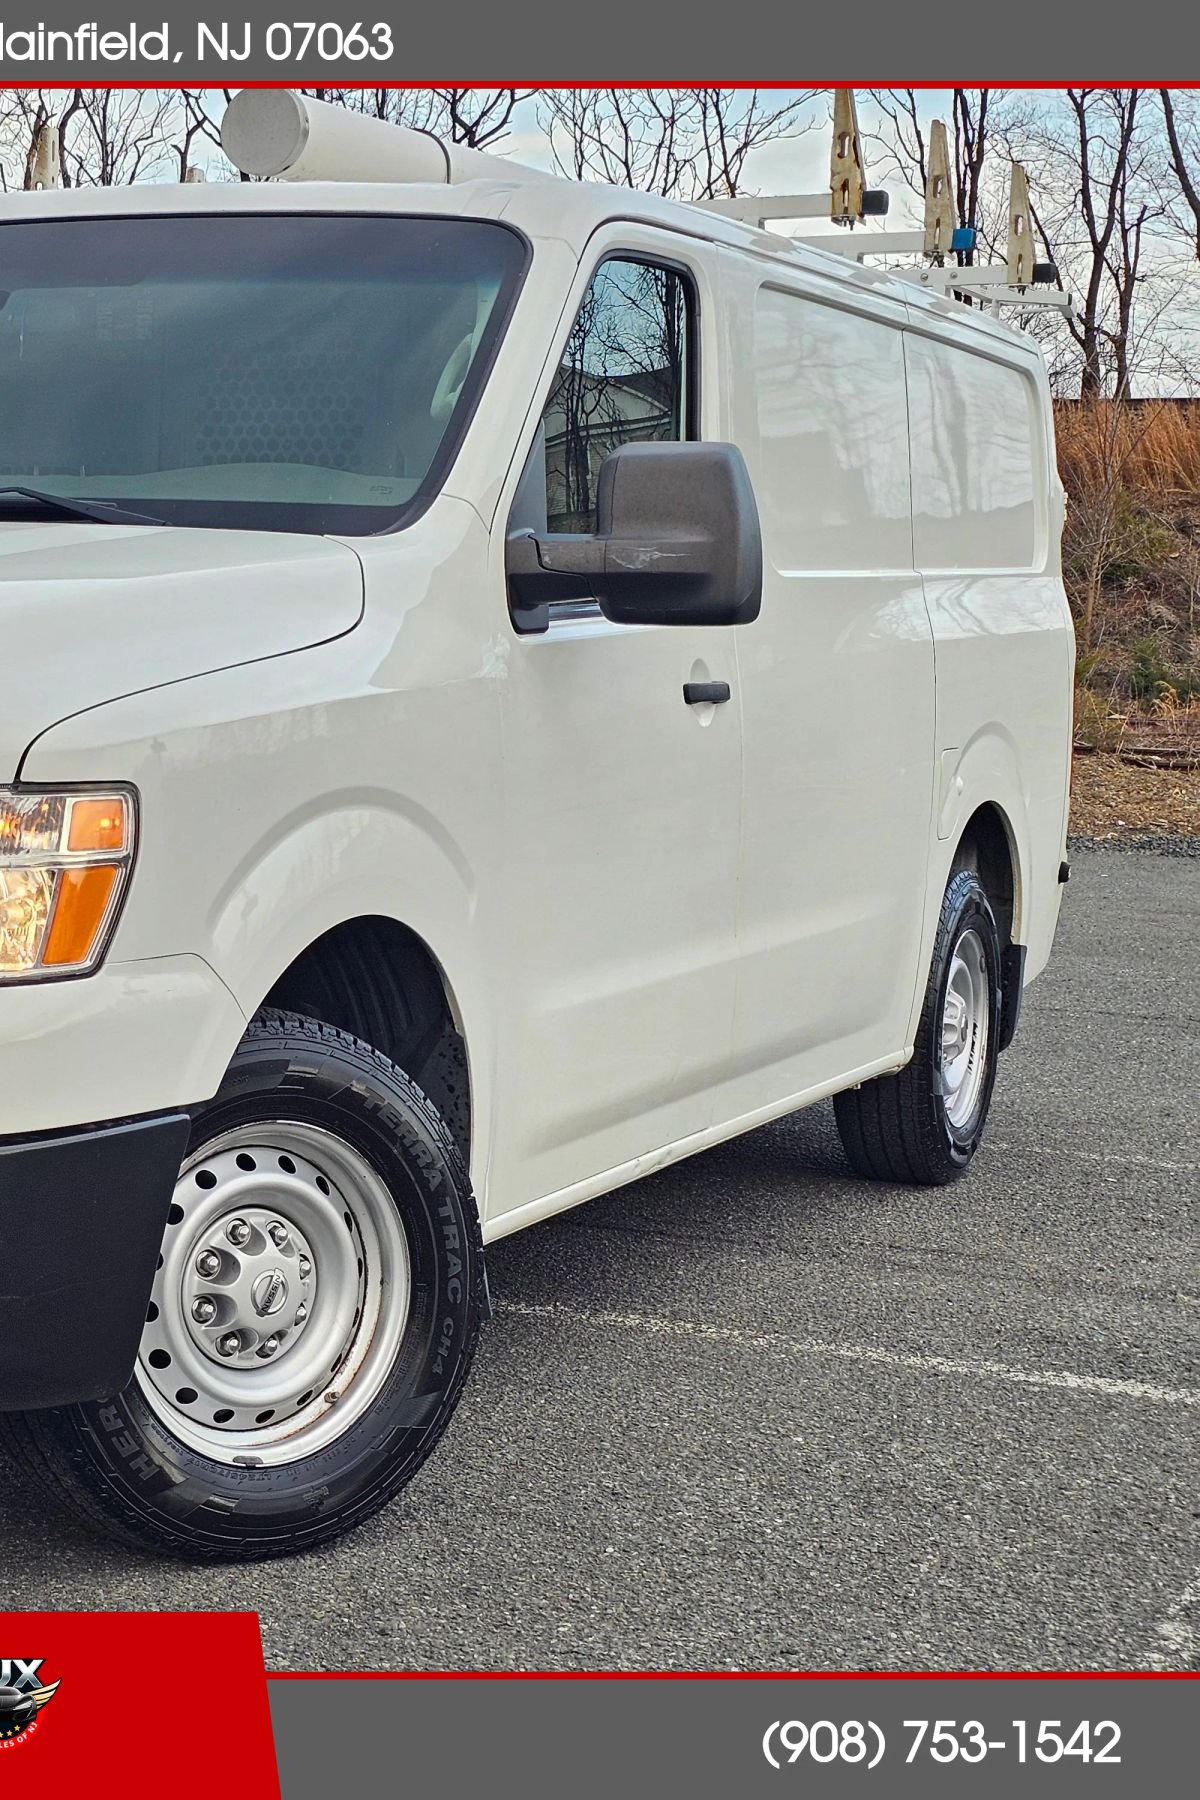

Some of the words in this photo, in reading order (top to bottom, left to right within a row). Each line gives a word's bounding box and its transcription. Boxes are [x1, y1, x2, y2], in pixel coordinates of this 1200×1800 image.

[362, 1086, 443, 1192] TERRA
[437, 1196, 462, 1305] TRAC
[261, 1274, 281, 1313] NISSAN
[432, 1316, 454, 1376] CH4
[96, 1397, 161, 1481] HER
